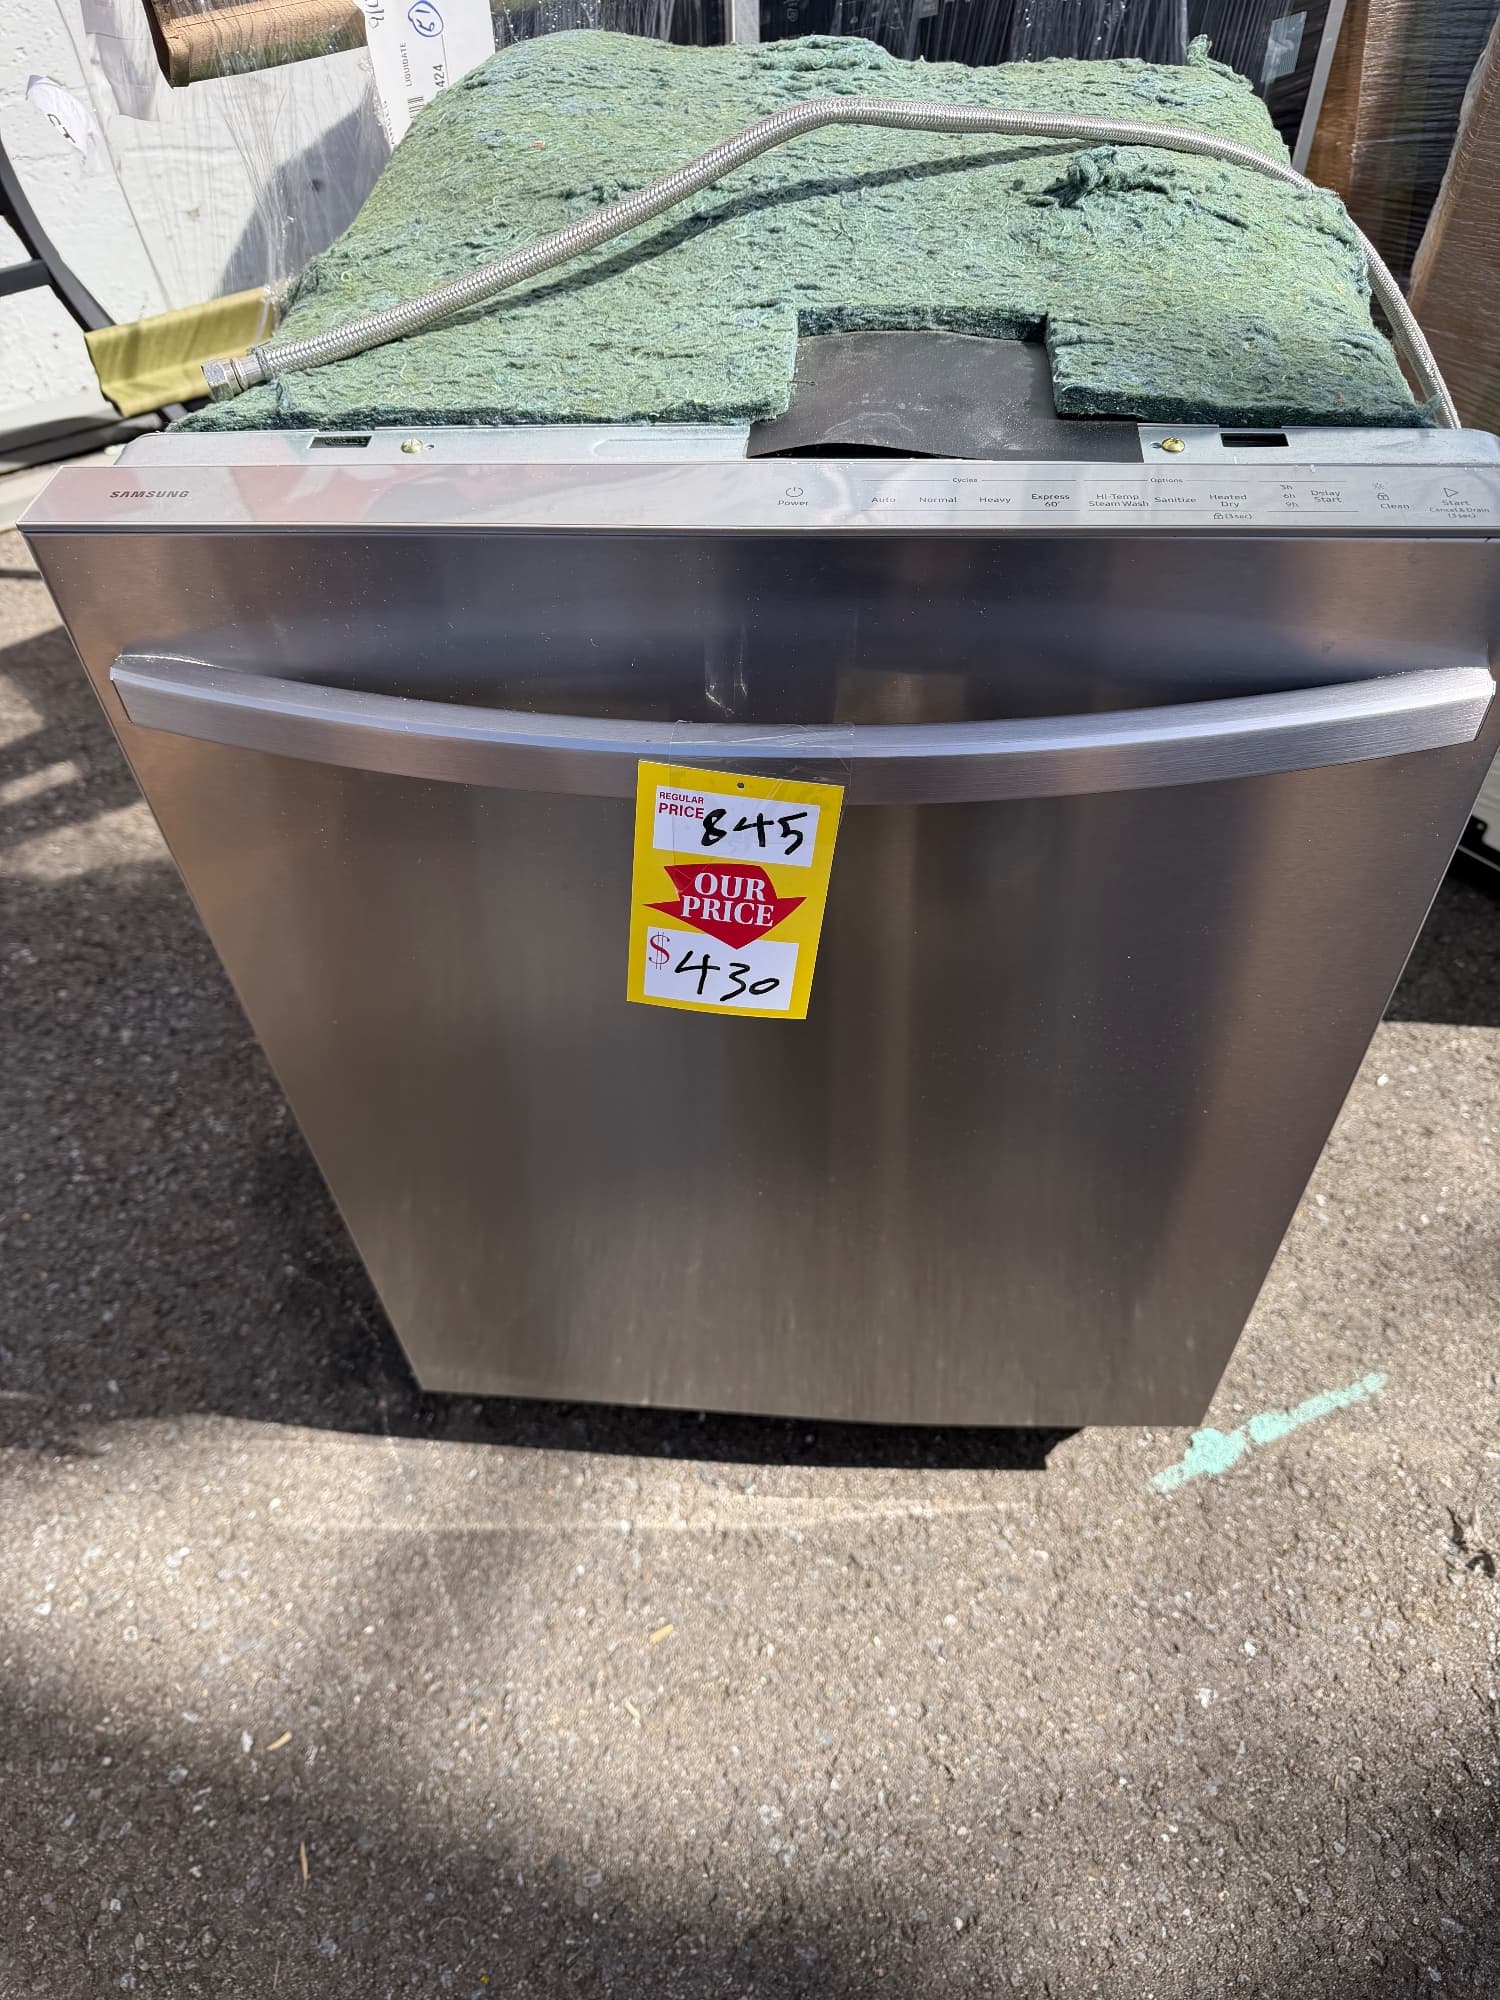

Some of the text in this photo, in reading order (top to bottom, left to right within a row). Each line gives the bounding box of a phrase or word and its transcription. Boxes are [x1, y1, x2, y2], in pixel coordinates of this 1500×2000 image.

[400, 41, 412, 87] LIQUIDATE
[109, 490, 190, 498] SAMSUNG
[1031, 493, 1070, 501] Express
[1096, 493, 1139, 501] Hi-Temp
[1310, 489, 1341, 497] Delay
[777, 499, 809, 507] Power
[979, 496, 1011, 504] Heavy
[659, 791, 704, 804] REGULAR
[658, 803, 705, 820] PRICE
[701, 808, 808, 855] 845
[694, 872, 766, 902] OUR
[680, 895, 775, 927] PRICE
[648, 931, 780, 1002] $ 430
